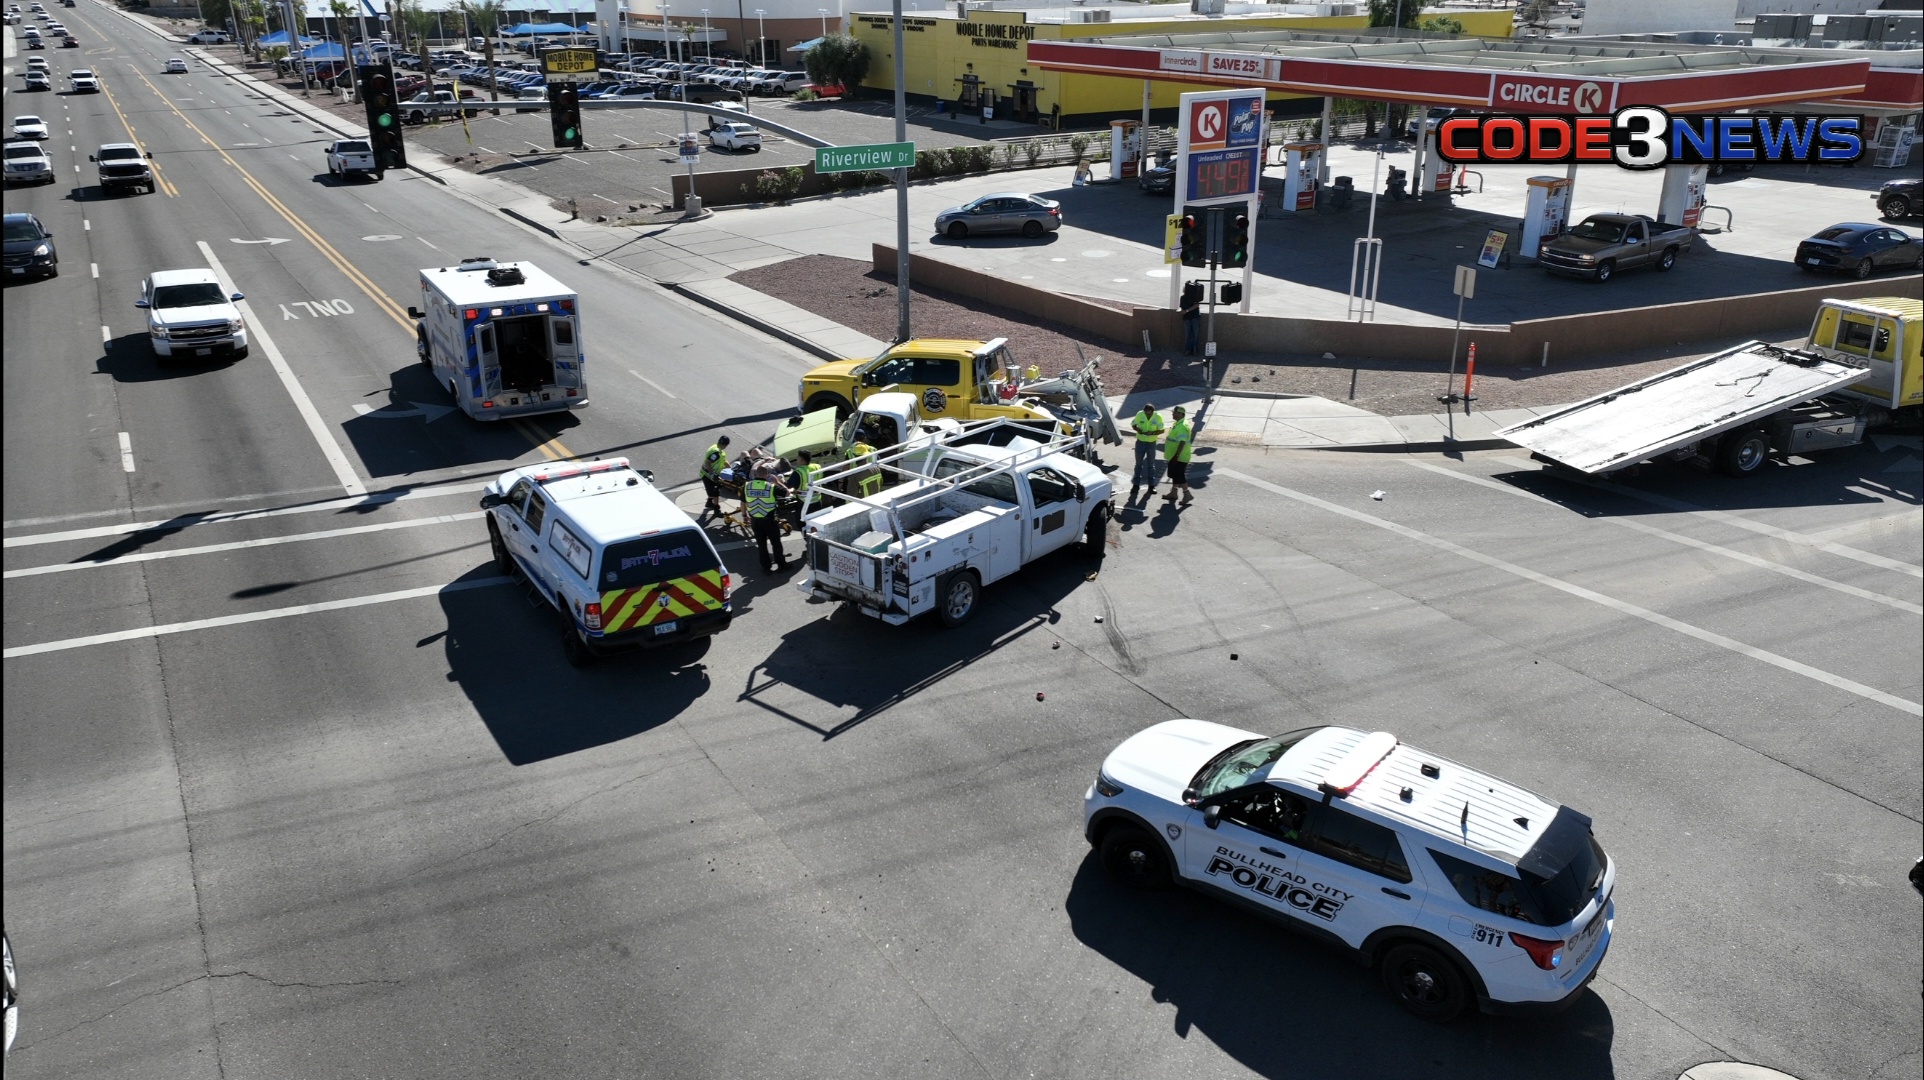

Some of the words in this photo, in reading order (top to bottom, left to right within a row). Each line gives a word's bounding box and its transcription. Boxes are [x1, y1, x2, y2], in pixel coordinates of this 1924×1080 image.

[956, 21, 983, 37] MOBILE
[985, 23, 1007, 39] HOME
[1009, 25, 1035, 40] DEPOT
[971, 37, 987, 47] PARTS
[988, 38, 1018, 49] WAREHOUSE
[548, 51, 572, 62] MOBILE
[574, 52, 594, 61] HOME
[1164, 56, 1197, 66] innercircle
[557, 62, 584, 70] DEPOT
[1212, 58, 1240, 71] SAVE
[1500, 82, 1571, 106] CIRCLE
[1578, 86, 1600, 112] K
[1203, 112, 1219, 137] K
[1233, 111, 1251, 126] Polar
[1240, 120, 1254, 134] Pop
[822, 148, 892, 168] Riverview
[898, 152, 908, 162] Dr
[1197, 154, 1223, 162] Unleaded
[1226, 152, 1243, 160] CREDIT
[278, 298, 355, 321] ONLY
[830, 558, 858, 574] SUDDEN
[834, 567, 854, 579] STOPS
[1216, 846, 1307, 885] BULLHEAD
[1312, 882, 1354, 902] CITY
[1204, 854, 1345, 922] POLICE
[1476, 923, 1506, 936] EMERGENCY
[1476, 929, 1504, 948] 911
